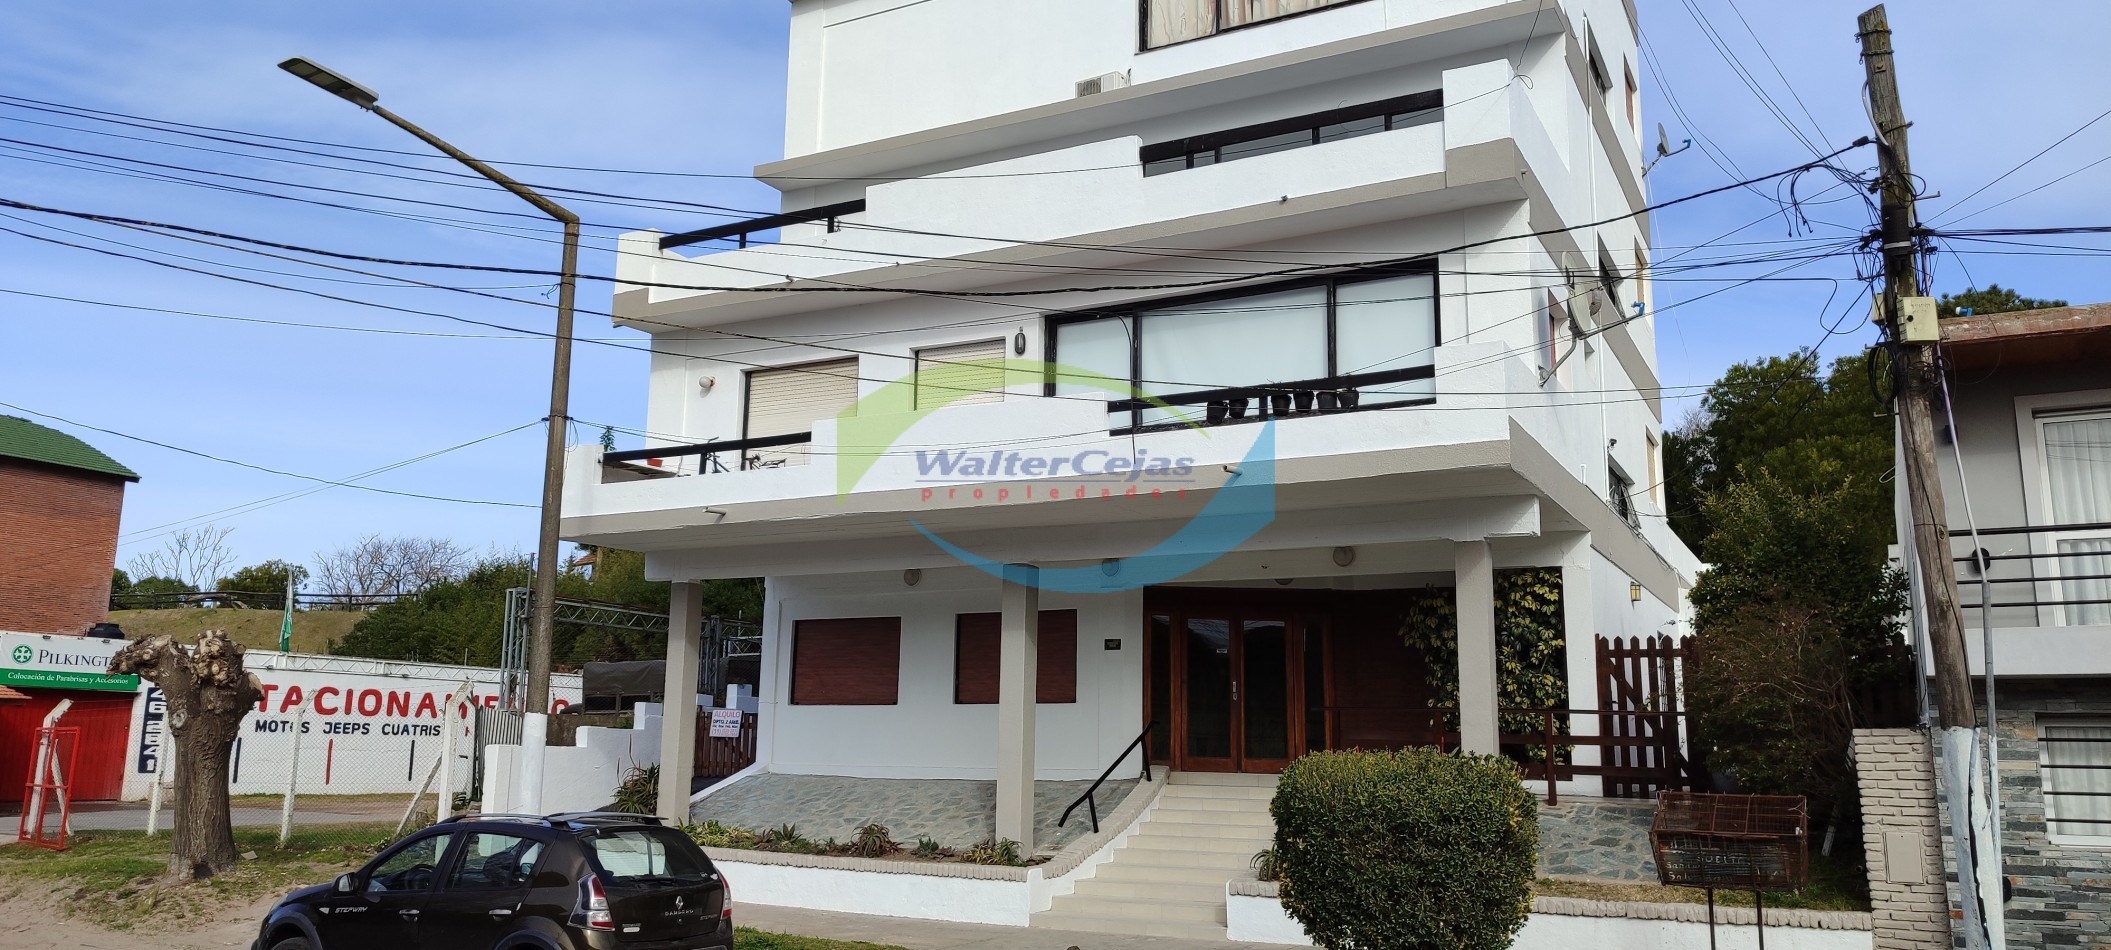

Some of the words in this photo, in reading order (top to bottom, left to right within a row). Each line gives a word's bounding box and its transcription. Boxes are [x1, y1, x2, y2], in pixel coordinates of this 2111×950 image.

[38, 649, 112, 667] PILKINGT
[8, 672, 45, 681] Colocación
[56, 675, 88, 683] Parabrisas
[323, 722, 371, 735] JEEPS
[382, 723, 441, 737] CUATRIS
[334, 906, 369, 914] STEPWAY
